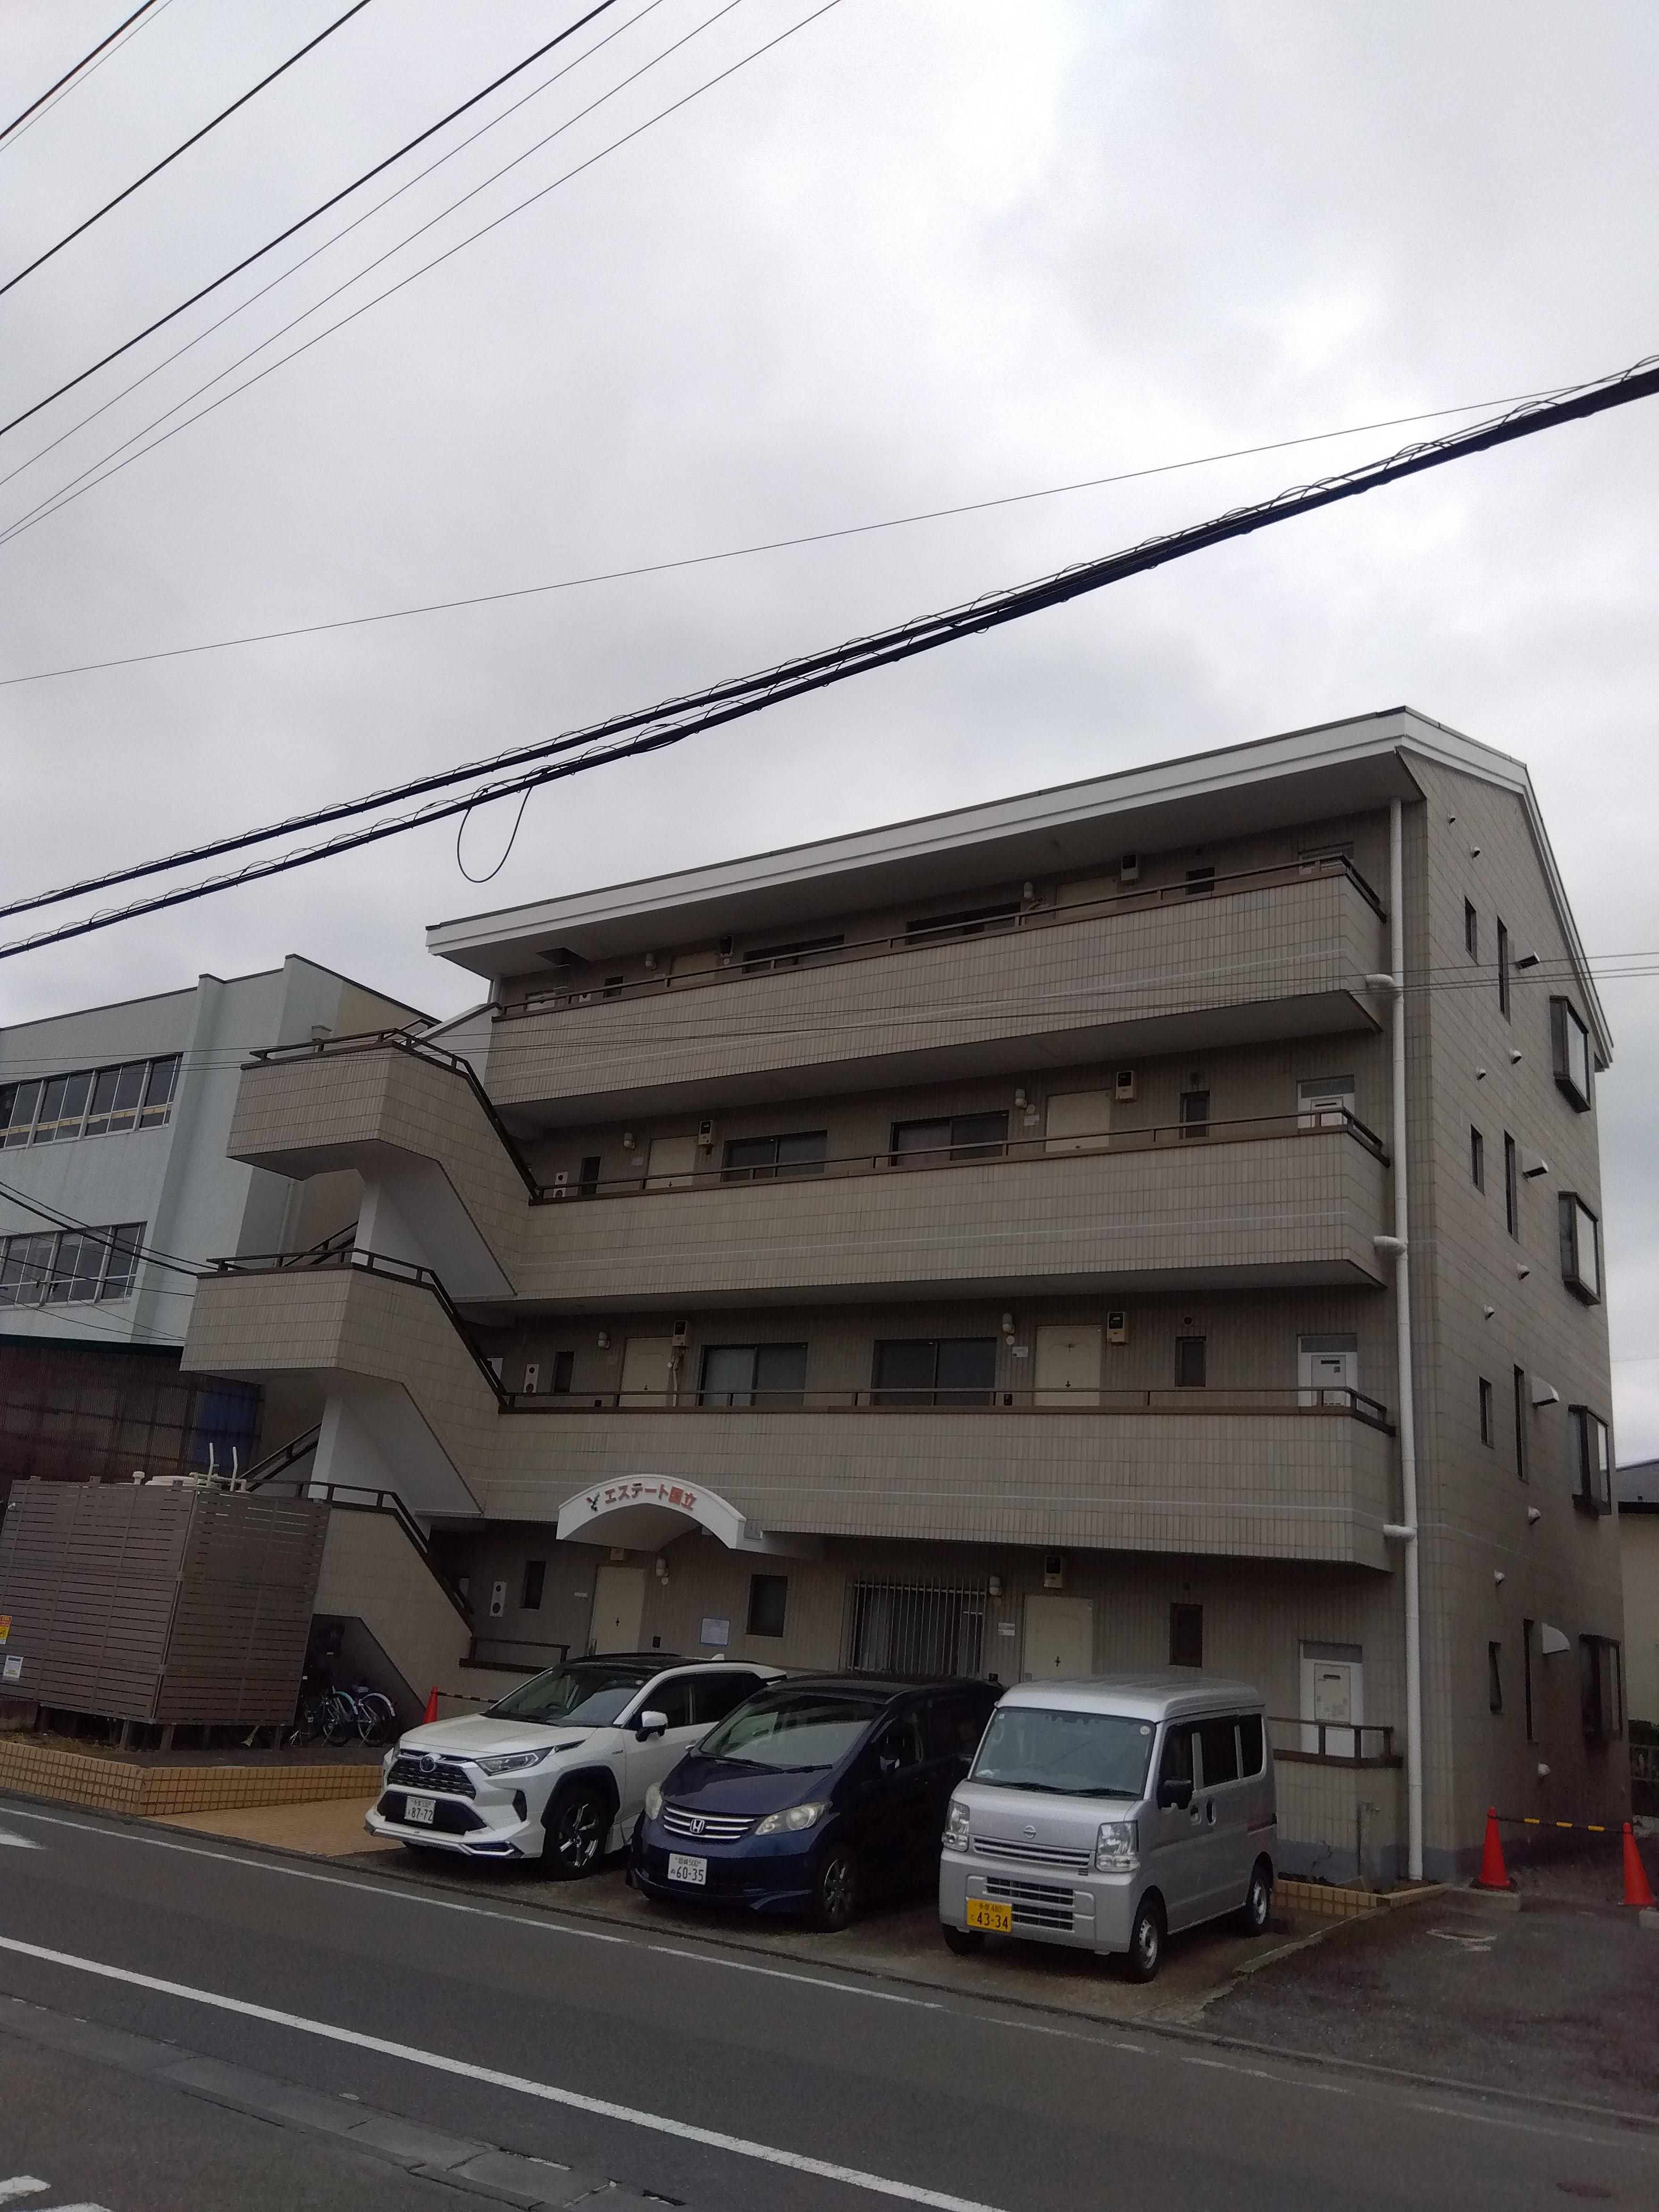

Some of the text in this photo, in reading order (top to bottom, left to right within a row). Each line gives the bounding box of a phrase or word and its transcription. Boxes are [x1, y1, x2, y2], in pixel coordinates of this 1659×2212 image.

[412, 1807, 433, 1821] 87-72
[676, 1866, 704, 1882] 60-35
[977, 1912, 1009, 1930] 43-34
